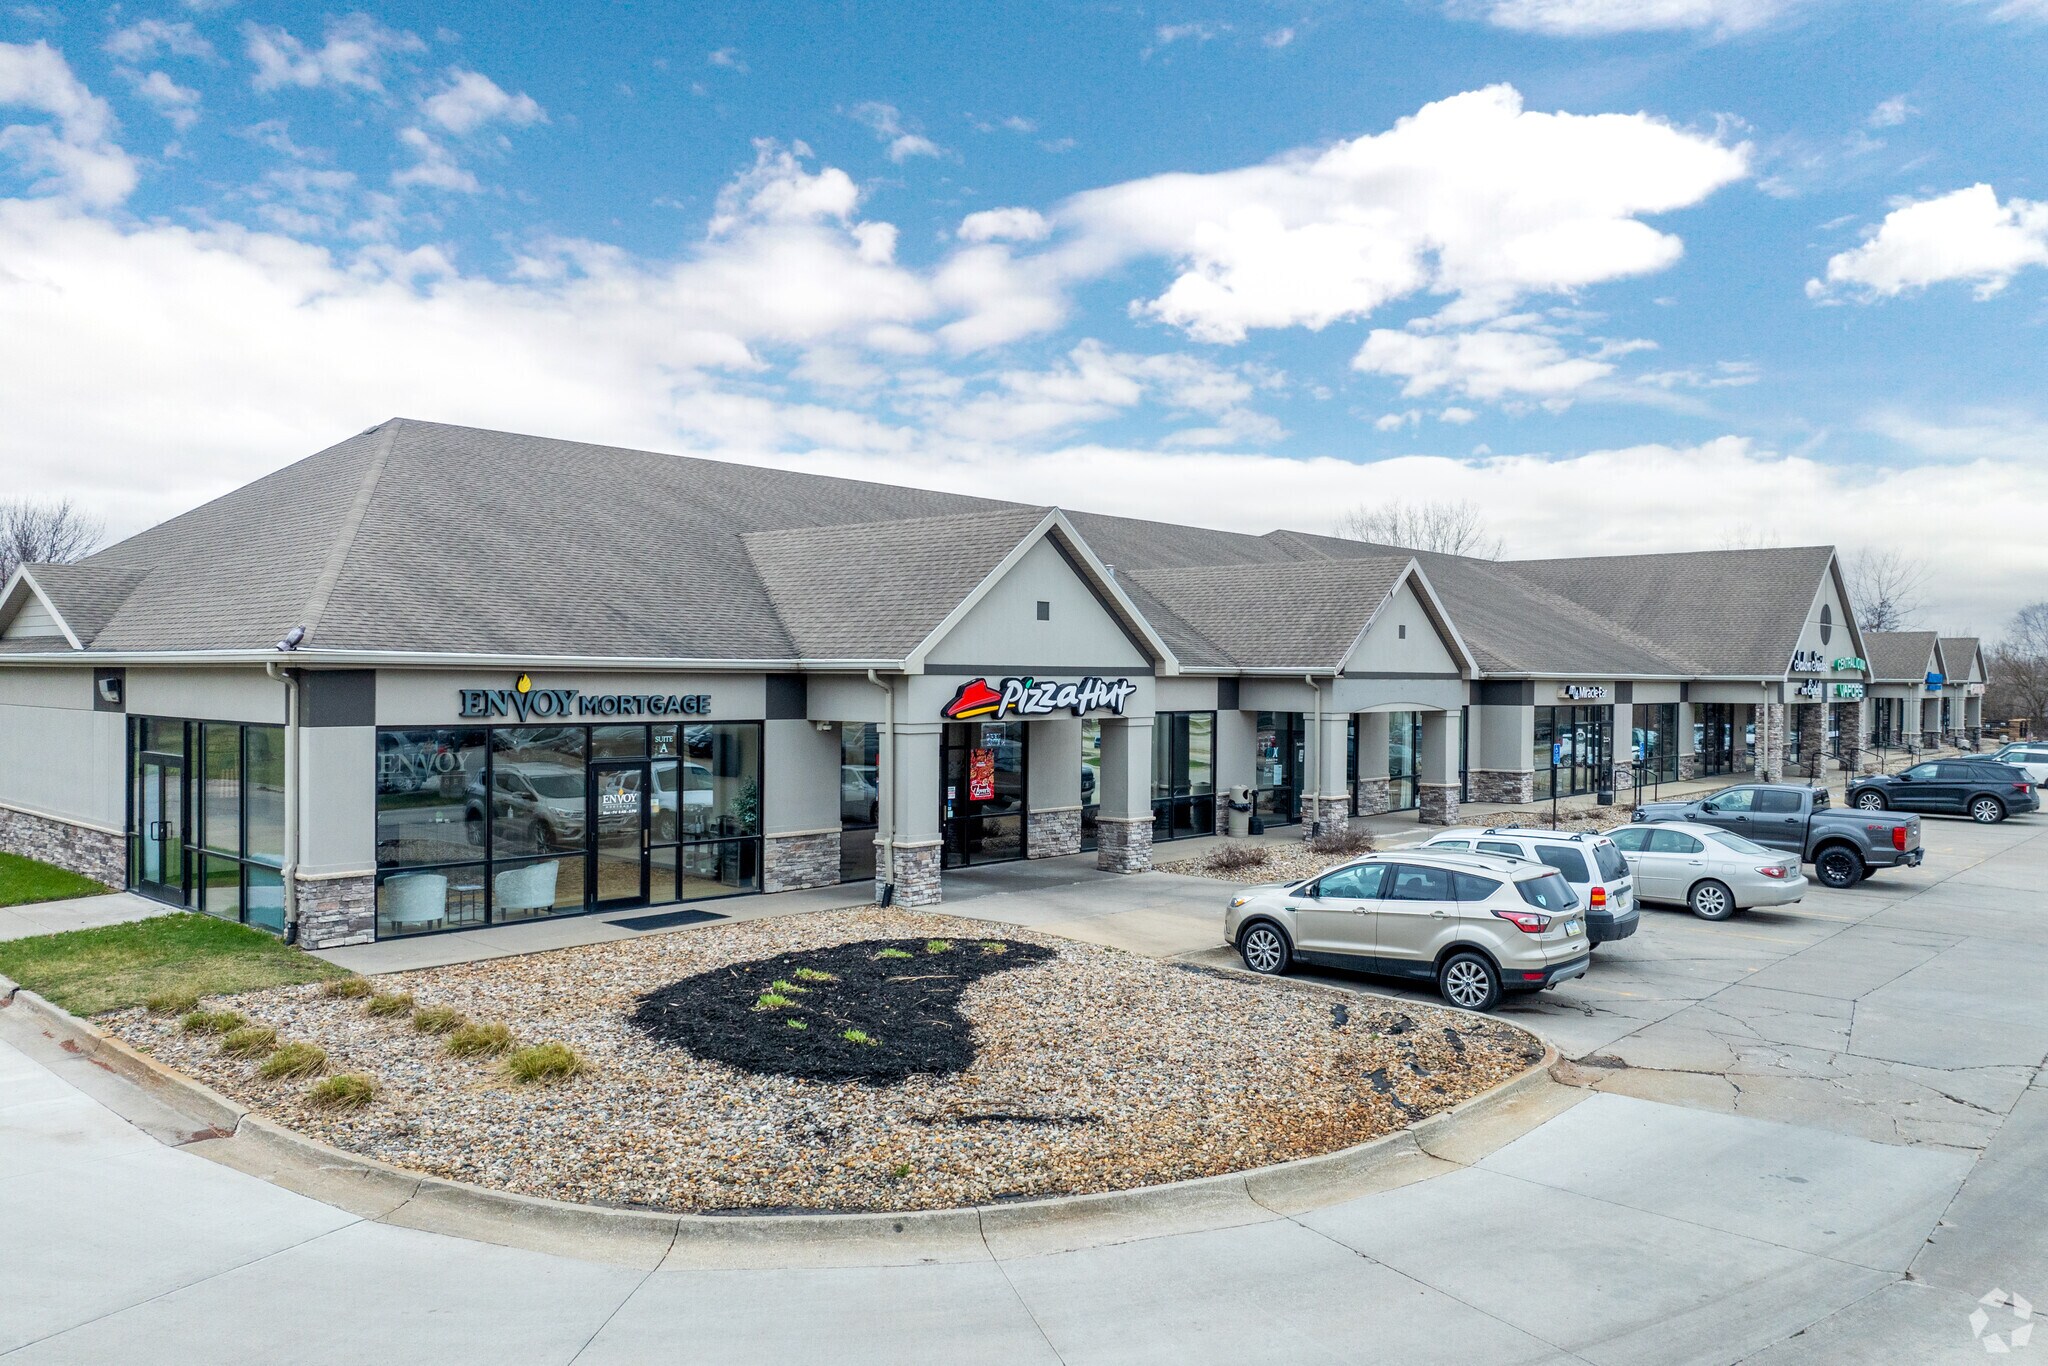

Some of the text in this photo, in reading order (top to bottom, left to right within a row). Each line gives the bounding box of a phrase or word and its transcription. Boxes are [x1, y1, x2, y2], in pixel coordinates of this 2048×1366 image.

[997, 677, 1136, 719] Pizza Hut
[1838, 684, 1863, 698] VAPORS
[459, 689, 711, 722] ENVOY MORTGAGE
[655, 735, 673, 743] SUITE
[660, 743, 668, 753] A
[378, 752, 472, 778] ENVOY
[603, 793, 637, 804] ENVOY
